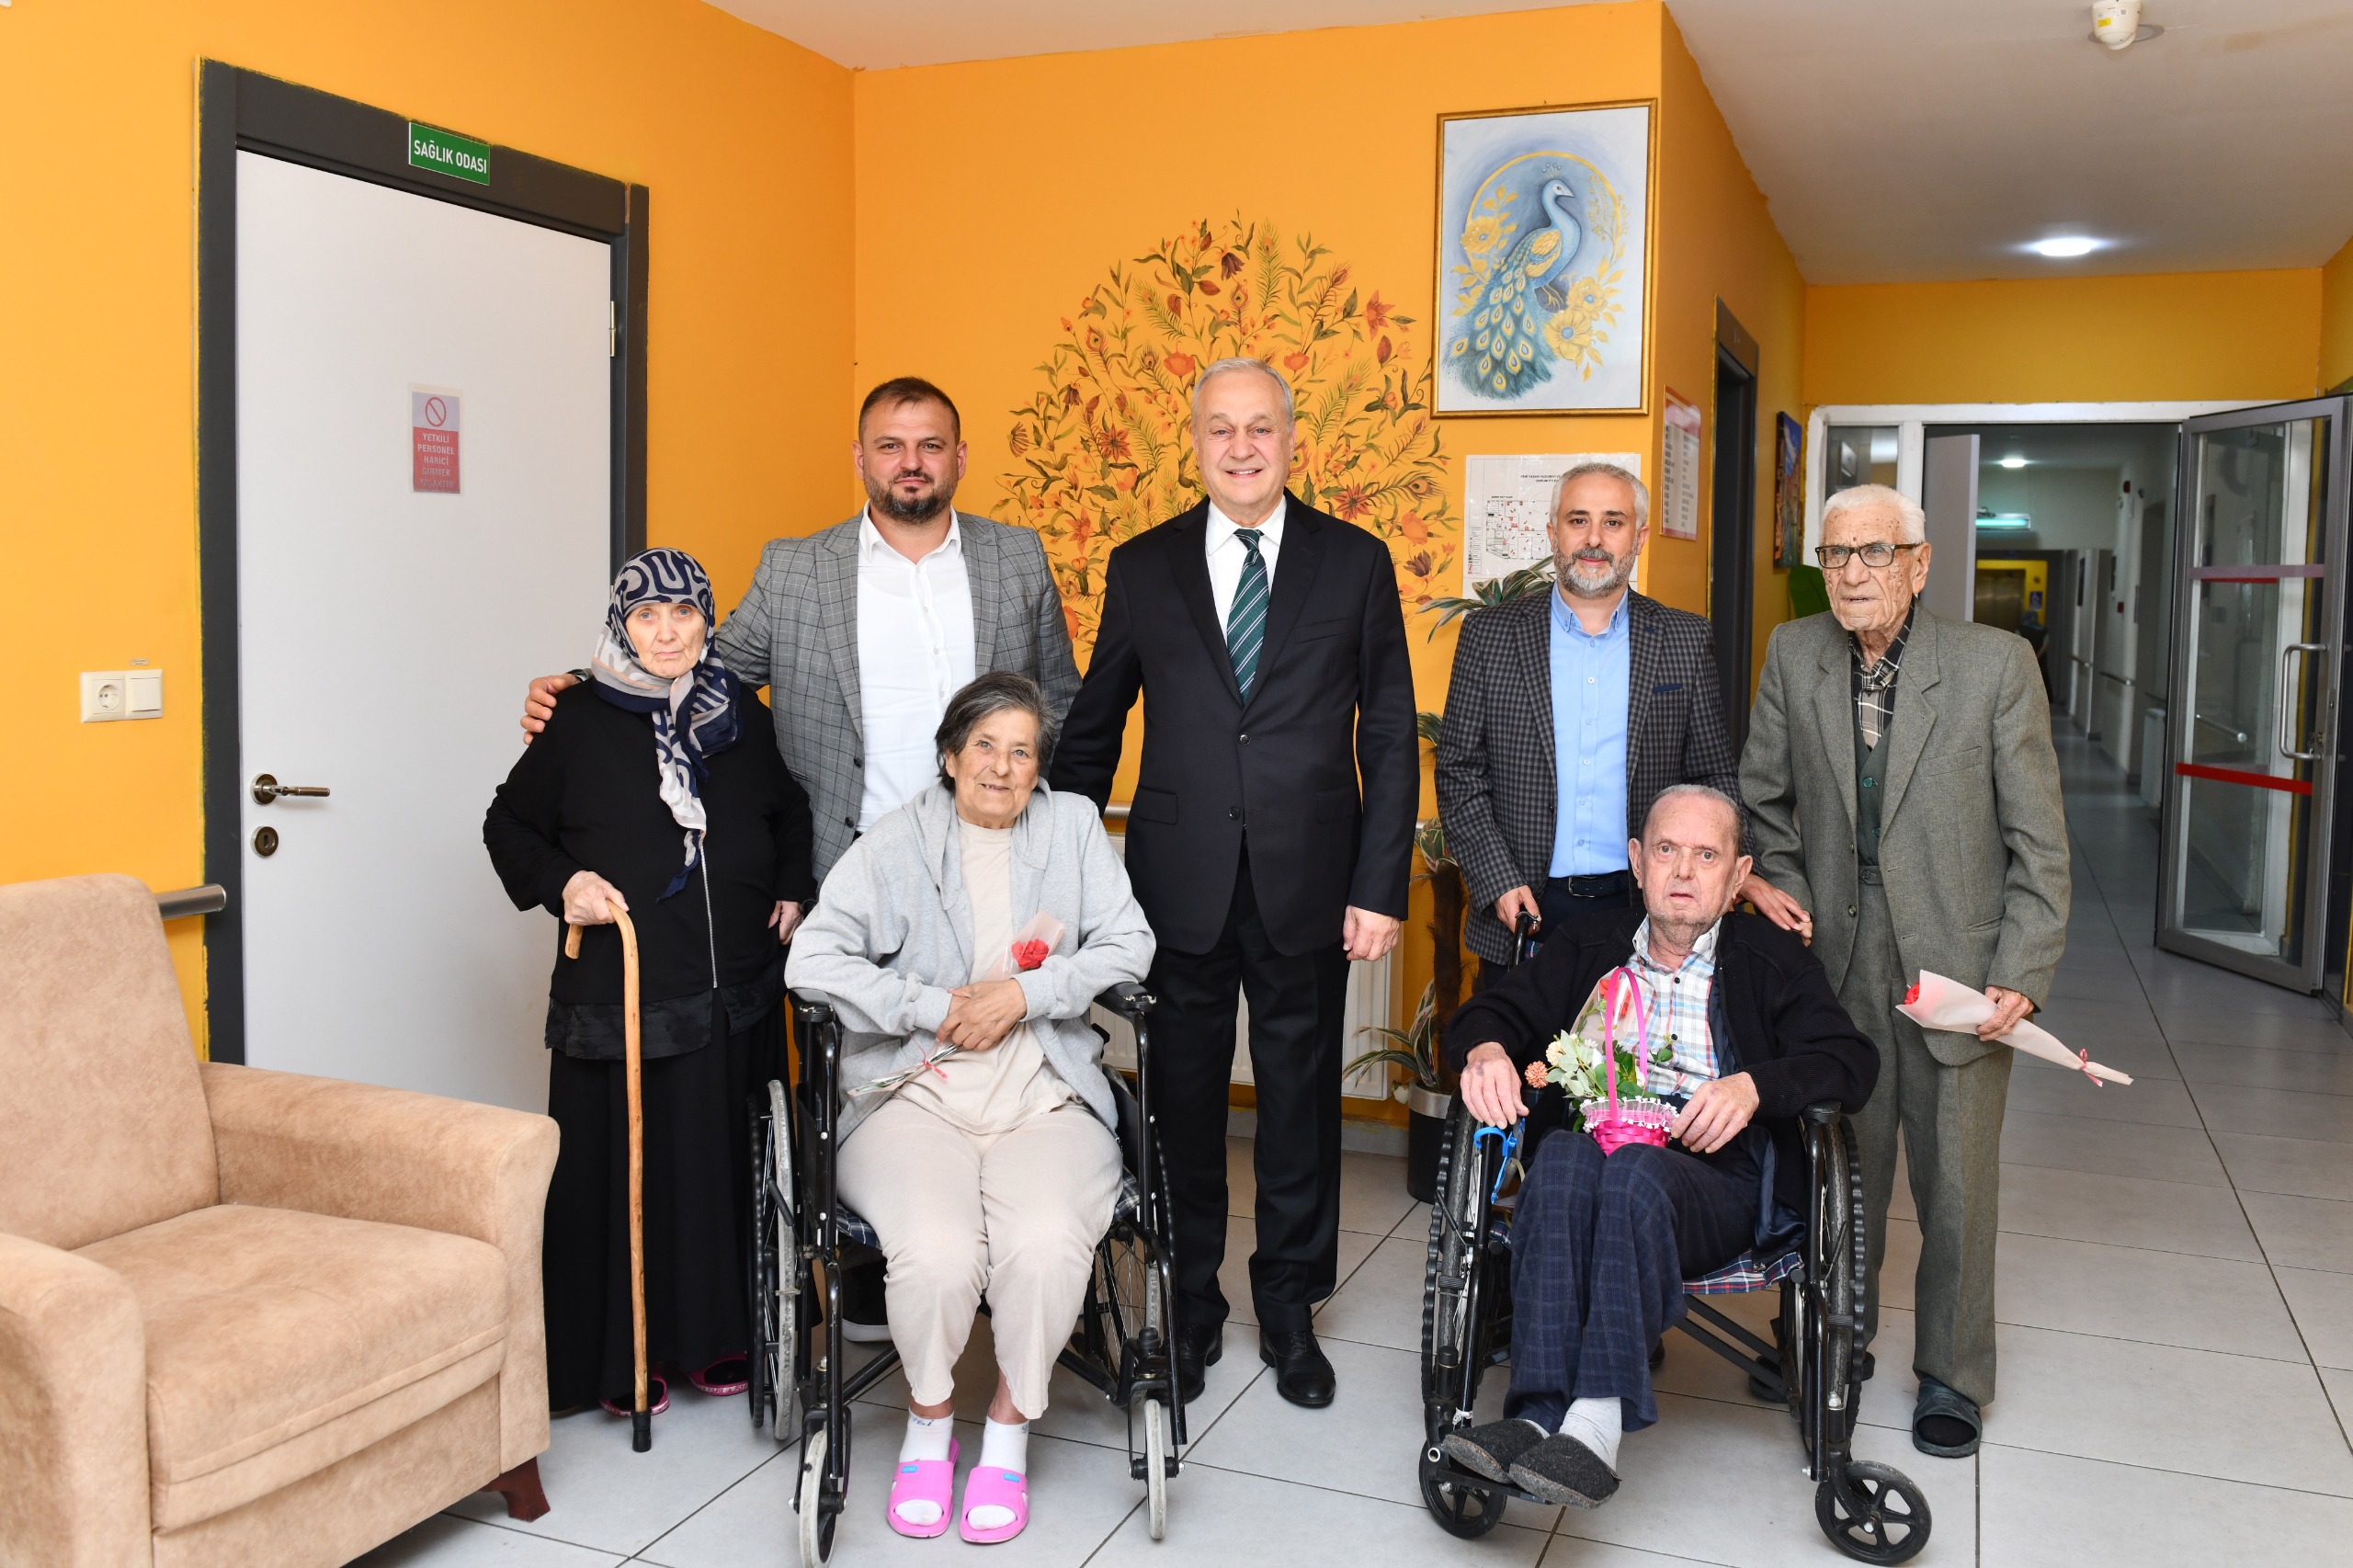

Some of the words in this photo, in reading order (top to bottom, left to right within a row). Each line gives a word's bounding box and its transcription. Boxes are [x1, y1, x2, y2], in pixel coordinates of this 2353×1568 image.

[414, 140, 453, 165] SAĞLIK
[456, 152, 487, 174] ODASI
[422, 432, 449, 443] YETKİLİ
[417, 444, 455, 455] PERSONEL
[424, 456, 449, 465] HARİCİ
